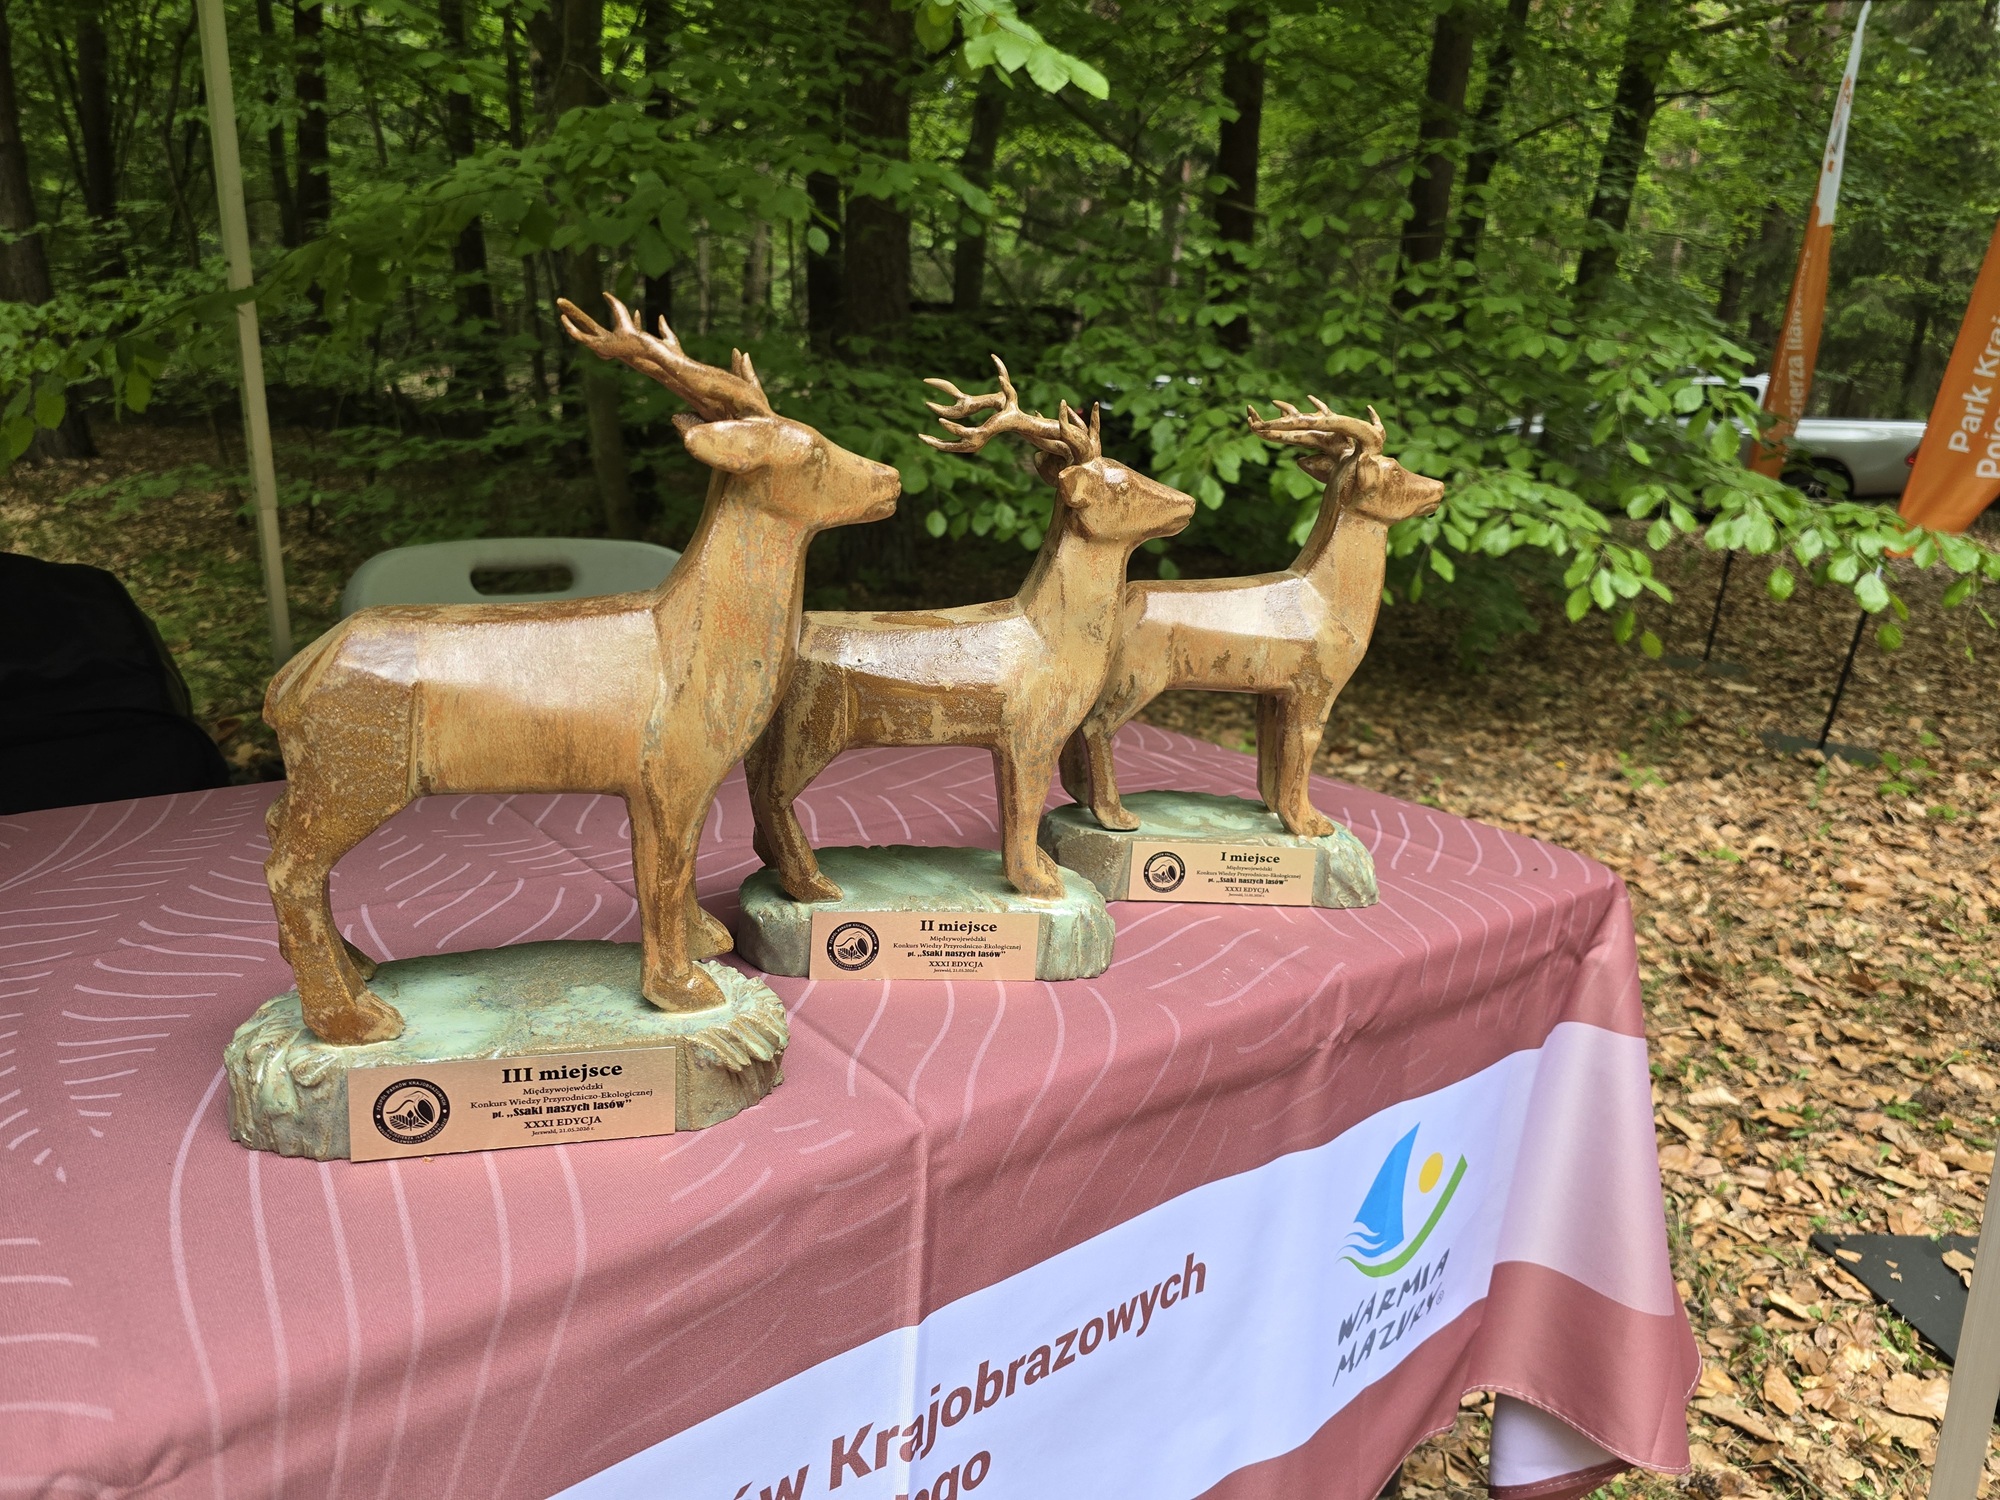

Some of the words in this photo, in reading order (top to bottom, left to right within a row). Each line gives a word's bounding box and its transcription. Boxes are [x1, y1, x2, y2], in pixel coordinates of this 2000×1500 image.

[1948, 384, 1993, 453] Park
[1220, 852, 1227, 861] I
[1230, 852, 1280, 865] miejsce
[920, 920, 935, 931] II
[938, 920, 998, 935] miejsce
[502, 1067, 533, 1084] III
[539, 1063, 623, 1082] miejsce
[523, 1083, 603, 1095] Międzywojewódzki
[470, 1100, 507, 1109] Konkurs
[543, 1089, 653, 1104] Przyrodniczo-Ekologicznej
[492, 1111, 504, 1119] pt.
[546, 1103, 590, 1114] naszych
[524, 1119, 554, 1129] XXXI
[556, 1116, 602, 1126] EDYCJA
[1338, 1247, 1450, 1346] WARMIA
[829, 1252, 1206, 1491] Krajobrazowych
